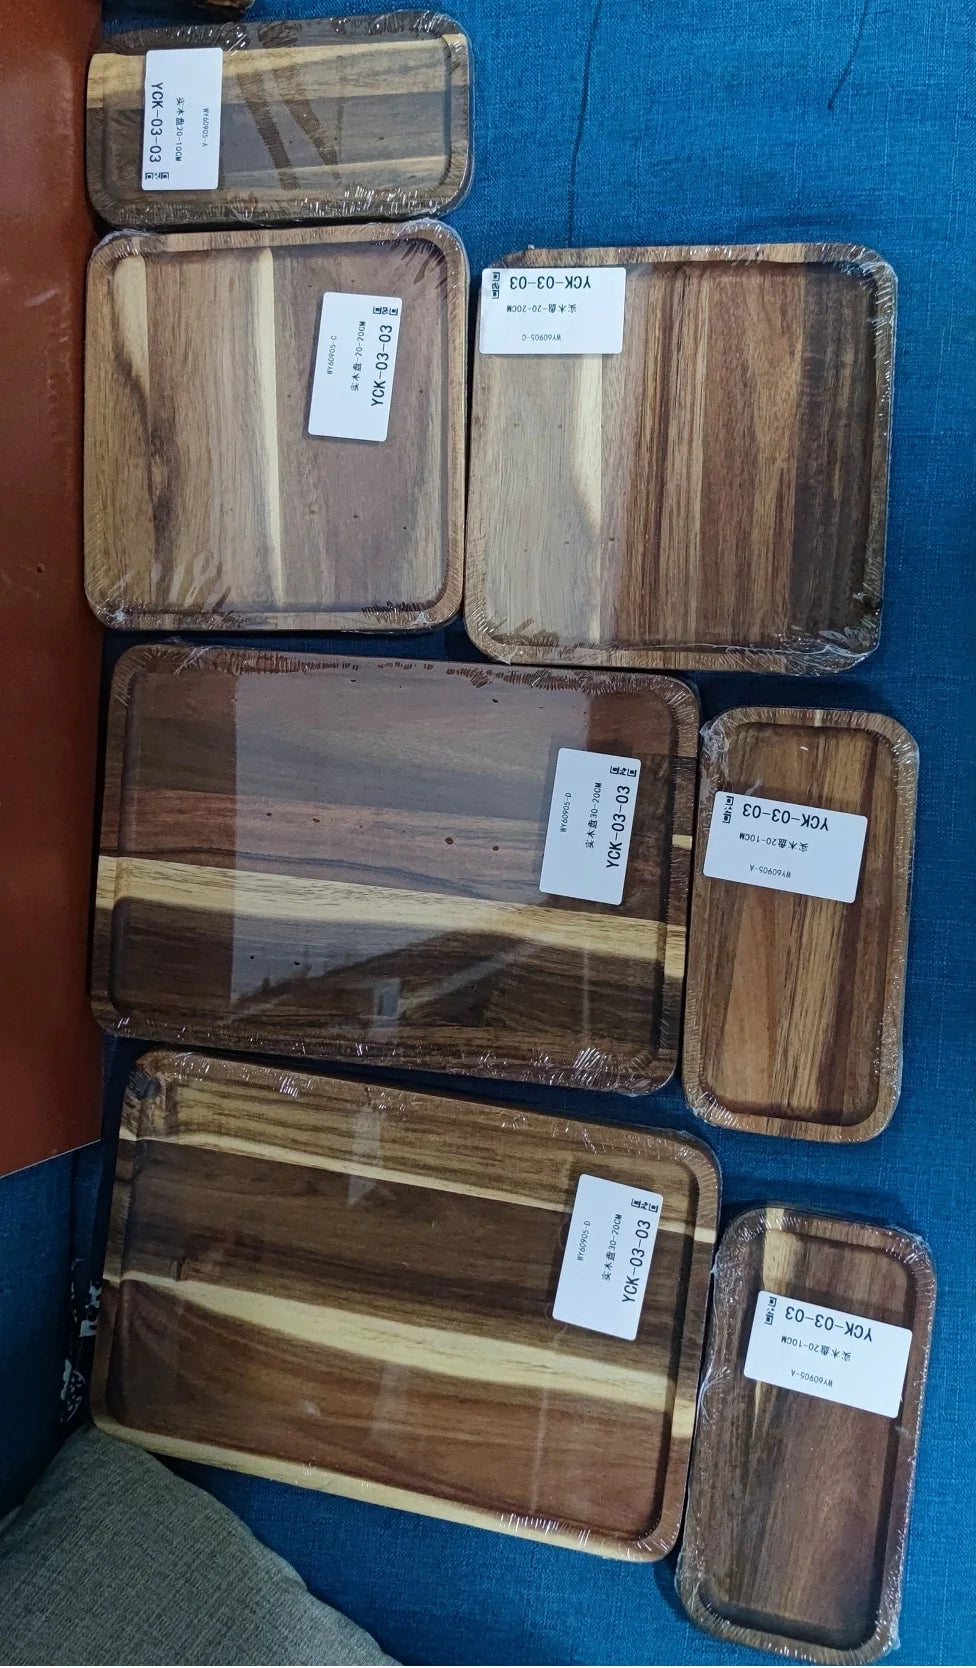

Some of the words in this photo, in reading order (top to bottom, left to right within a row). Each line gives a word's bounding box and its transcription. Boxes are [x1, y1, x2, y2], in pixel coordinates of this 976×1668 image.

[149, 82, 164, 163] YCK-03-03
[175, 96, 186, 162] 实木盘20-10CM
[201, 108, 210, 148] WY60905-A
[509, 275, 592, 290] YCK-03-03
[507, 303, 577, 313] 实木盘-20-20CM
[326, 335, 338, 376] WY60905-C
[350, 321, 369, 393] 实木盘-20-20CM
[521, 333, 562, 342] WY60905-C
[370, 324, 393, 407] YCK-03-03
[559, 792, 574, 833] WY60905-D
[584, 782, 607, 850] 实木盘30-20CM
[606, 785, 631, 869] YCK-03-03
[742, 803, 830, 832] YCK-03-03
[737, 831, 809, 854] 实木盘20-10CM
[749, 863, 792, 879] WY60905-A
[576, 1218, 592, 1262] WY60905-D
[601, 1213, 624, 1283] 实木盘30-20CM
[621, 1219, 651, 1304] YCK-03-03
[784, 1306, 874, 1343] YCK-03-03
[780, 1335, 852, 1362] 实木盘20-10CM
[790, 1369, 834, 1388] WY60905-A
